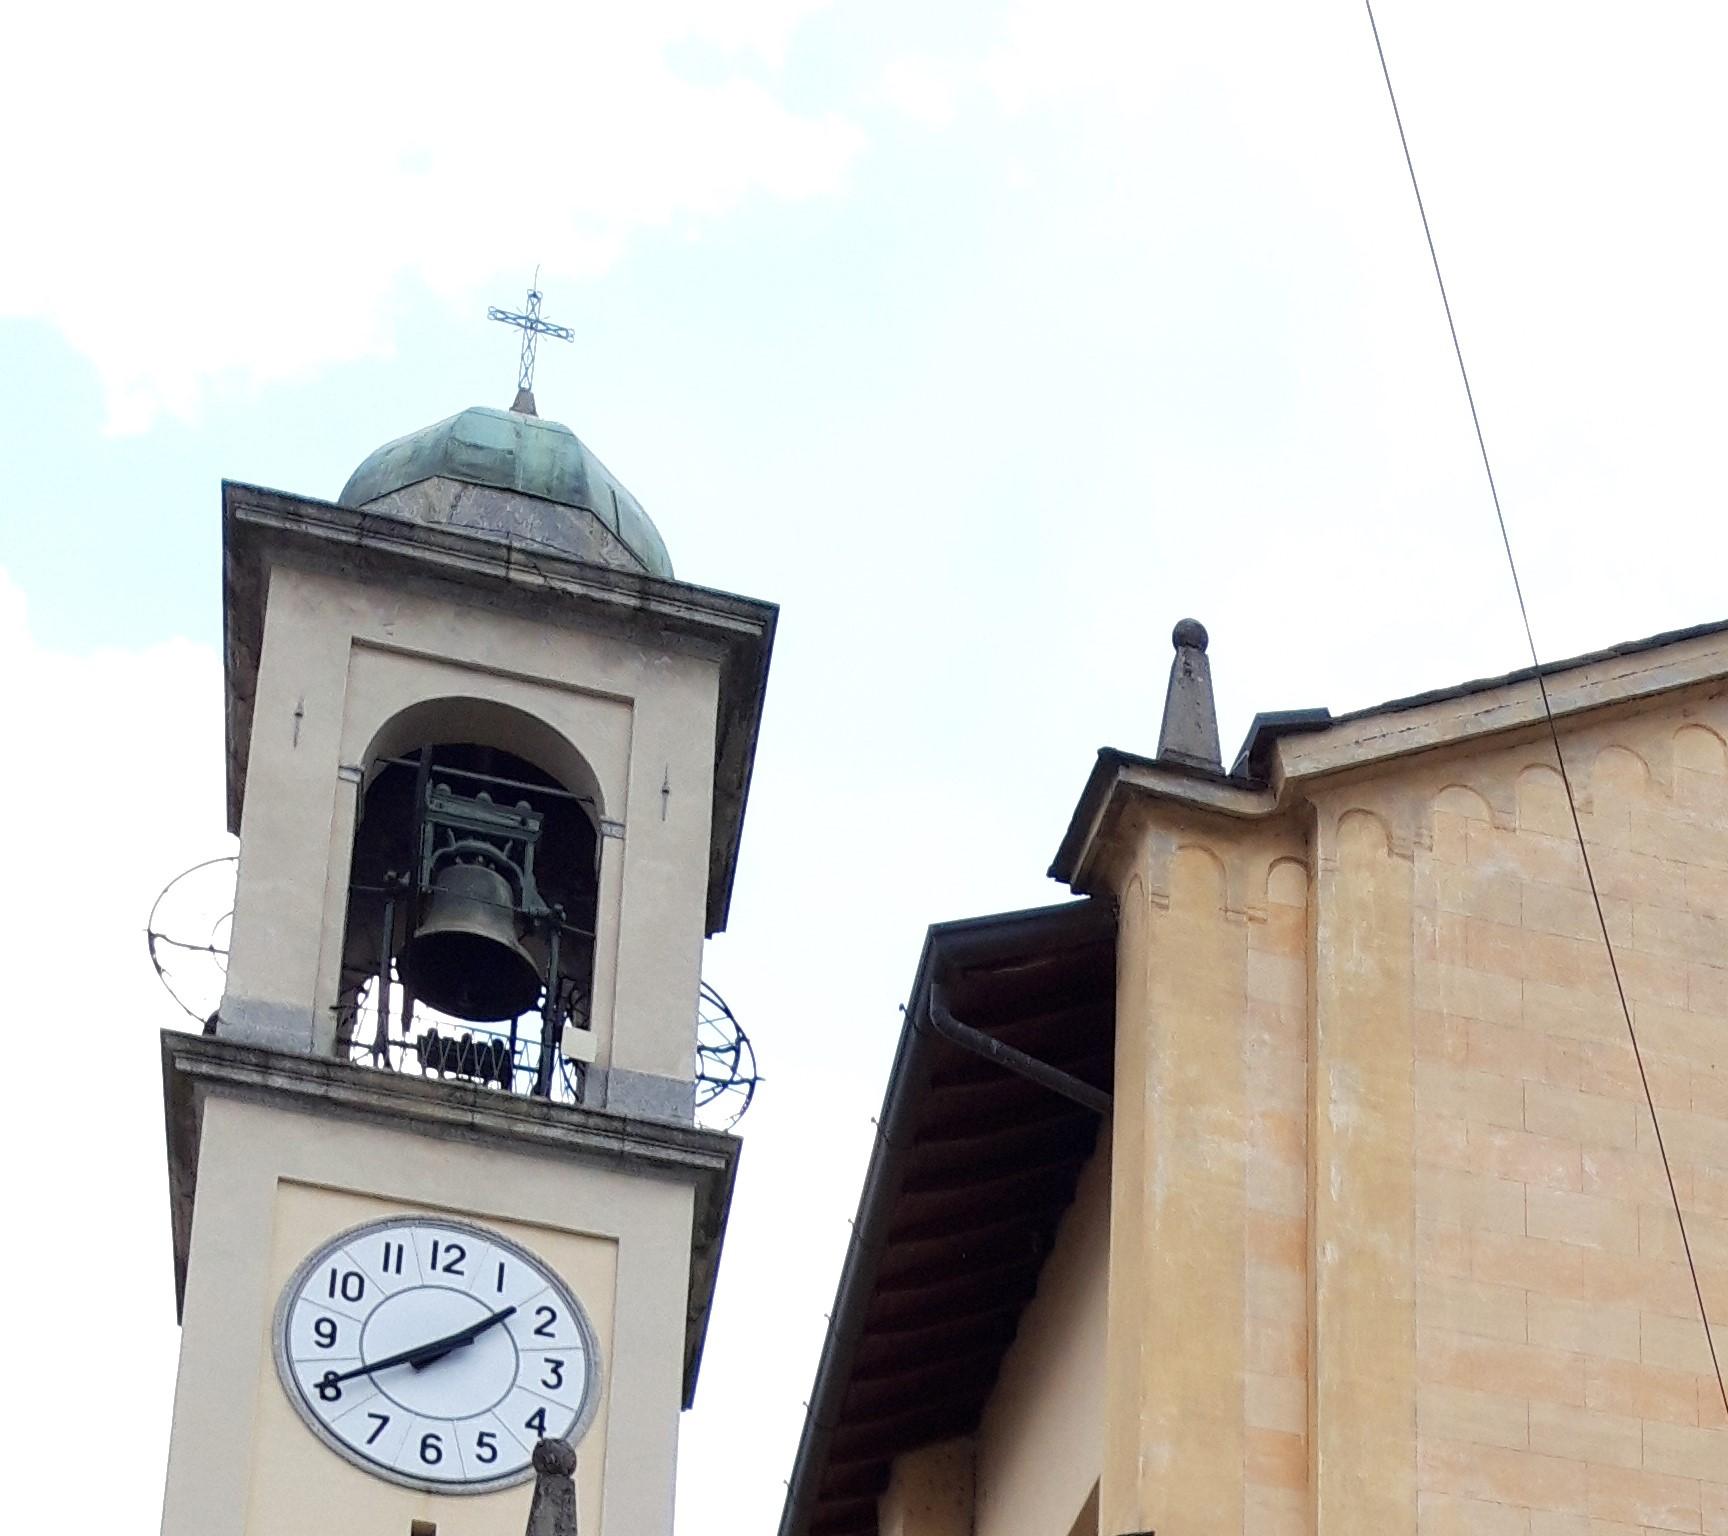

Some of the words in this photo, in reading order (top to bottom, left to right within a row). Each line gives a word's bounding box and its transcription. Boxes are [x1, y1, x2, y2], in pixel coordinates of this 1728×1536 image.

[383, 1242, 403, 1274] 11
[431, 1240, 466, 1275] 12
[329, 1268, 364, 1302] 10
[497, 1263, 504, 1292] 1
[315, 1317, 337, 1348] 9
[534, 1306, 556, 1338] 2
[542, 1358, 564, 1389] 3
[367, 1413, 390, 1444] 7
[525, 1407, 546, 1437] 4
[420, 1433, 442, 1464] 6
[476, 1432, 497, 1463] 5
